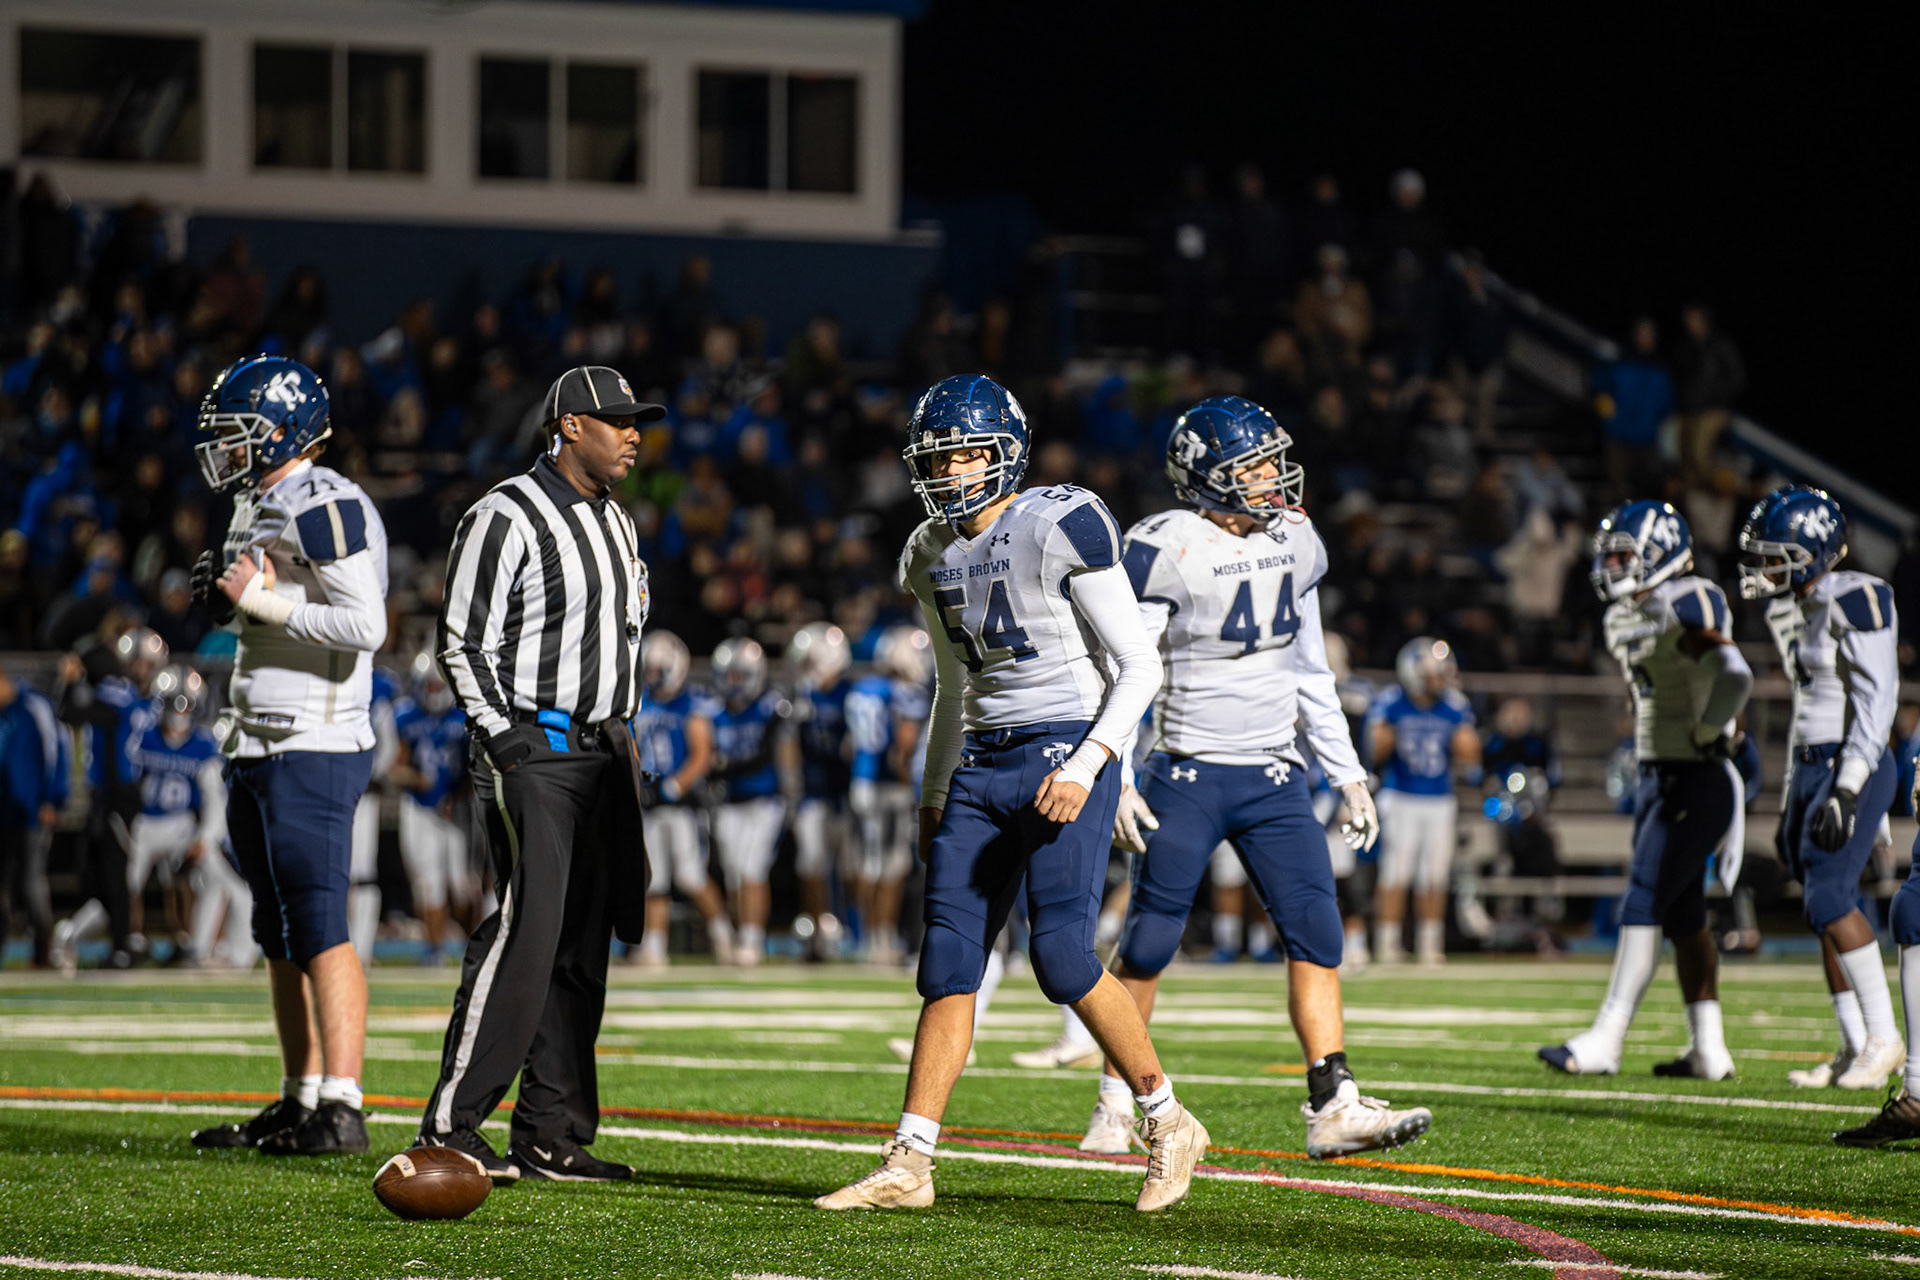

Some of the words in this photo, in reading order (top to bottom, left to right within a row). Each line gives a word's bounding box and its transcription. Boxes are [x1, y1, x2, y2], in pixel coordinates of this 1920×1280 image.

[930, 567, 963, 584] MOSES
[968, 558, 1011, 578] BROWN
[1212, 560, 1252, 577] MOSES
[1256, 553, 1297, 570] BROWN
[933, 576, 1042, 673] 54
[1219, 571, 1303, 657] 44
